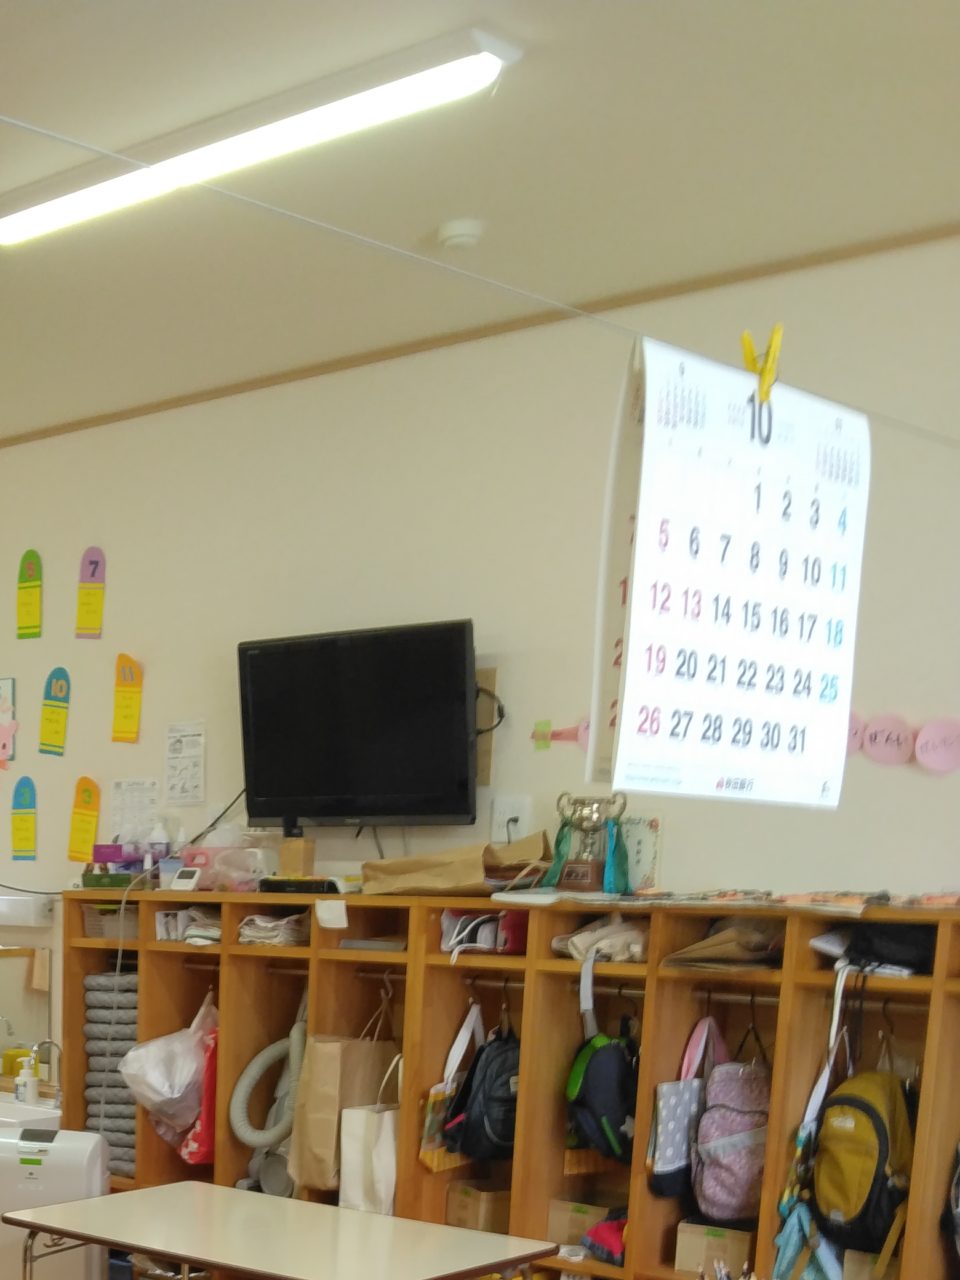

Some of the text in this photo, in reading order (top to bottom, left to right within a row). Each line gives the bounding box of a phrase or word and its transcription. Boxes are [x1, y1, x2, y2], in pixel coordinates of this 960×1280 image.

[746, 389, 773, 447] 10
[754, 482, 848, 536] 1 2 3 4
[27, 561, 35, 578] 5
[89, 560, 99, 578] 7
[658, 518, 670, 551] 5
[689, 525, 700, 559] 6
[720, 534, 732, 563] 7
[749, 541, 760, 573] 8
[778, 548, 789, 580] 9
[802, 555, 822, 586] 10
[831, 561, 847, 591] 11
[650, 580, 844, 648] 12 13 14 15 16 17 18
[50, 678, 67, 697] 10
[645, 643, 838, 703] 19 20 21 22 23 24 25
[637, 705, 807, 754] 26 27 28 29 30 31
